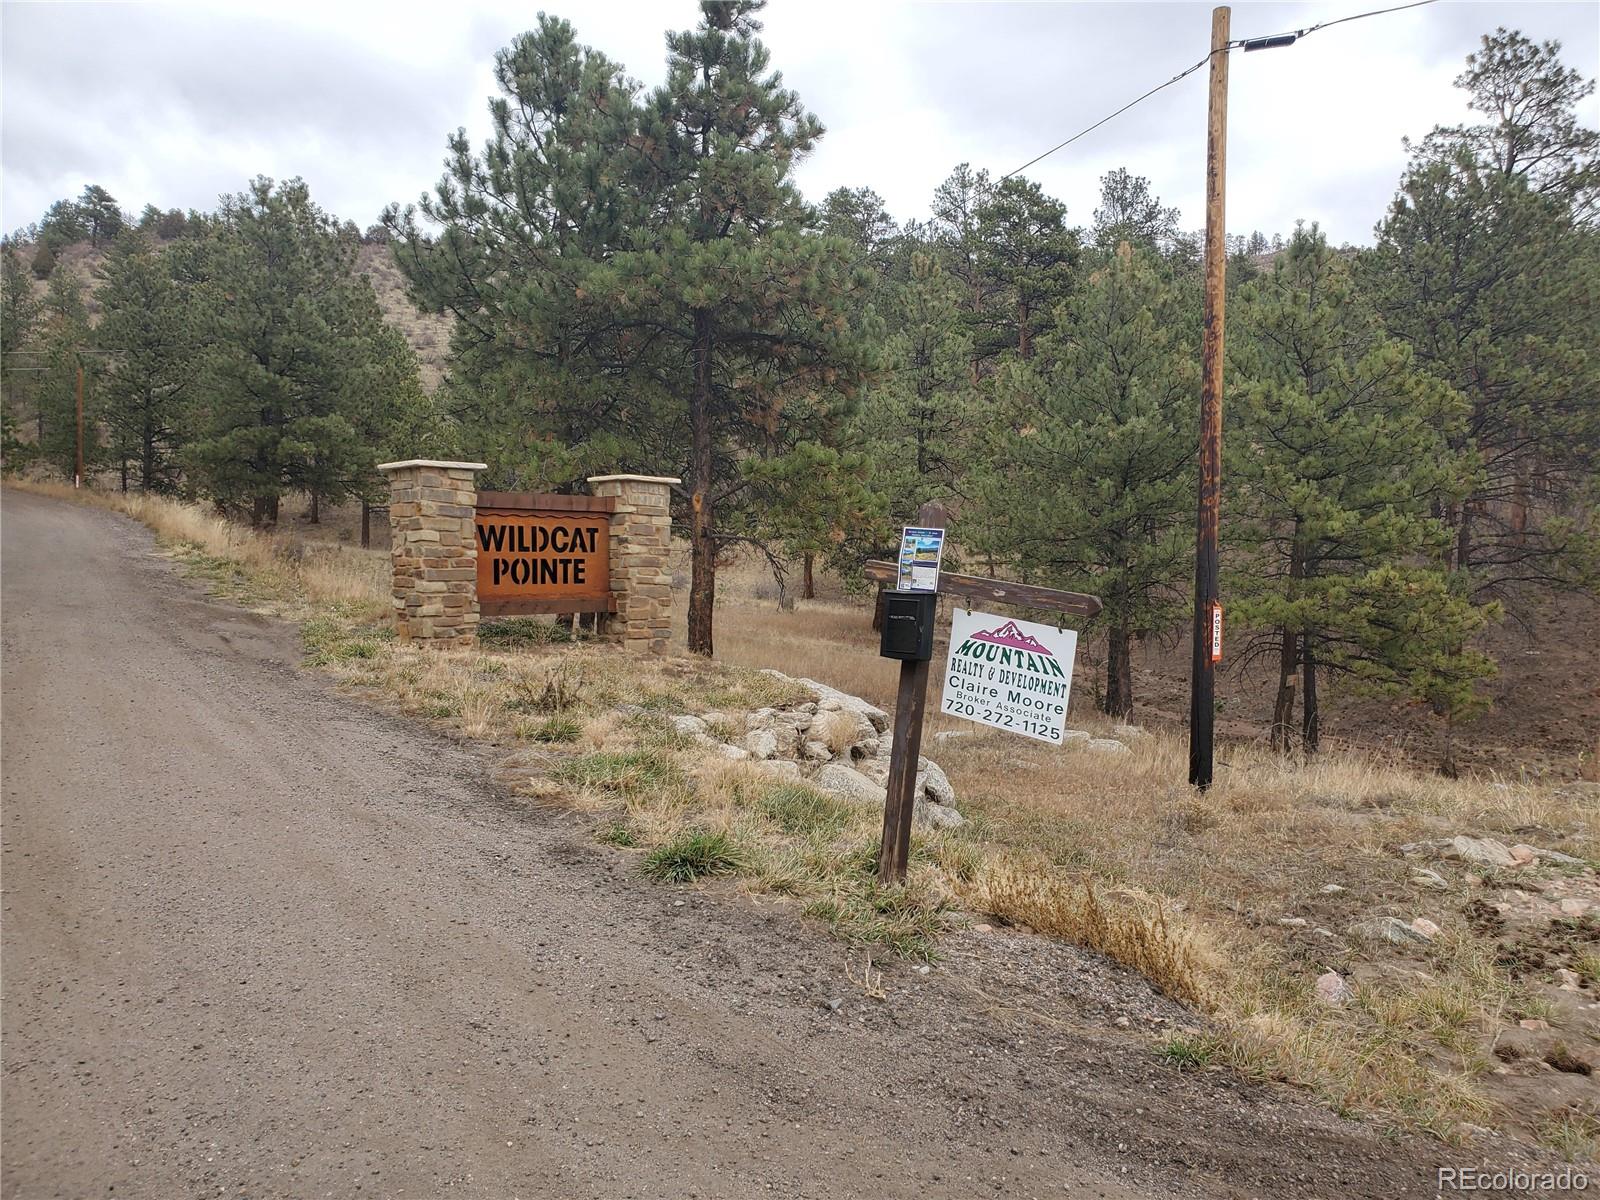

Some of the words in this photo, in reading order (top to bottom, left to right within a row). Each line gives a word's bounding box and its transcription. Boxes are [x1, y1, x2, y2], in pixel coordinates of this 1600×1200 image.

[477, 524, 599, 553] WILDCAT
[493, 558, 586, 585] POINTE
[950, 657, 985, 679] REALTY
[988, 666, 996, 681] &
[998, 669, 1067, 699] DEVELOPMENT
[955, 639, 1066, 679] MOUNTAIN
[949, 675, 998, 698] Claire
[1007, 690, 1064, 715] Moore
[956, 690, 991, 707] Broker
[995, 701, 1052, 723] Associate
[946, 698, 1060, 740] 720-272-1125
